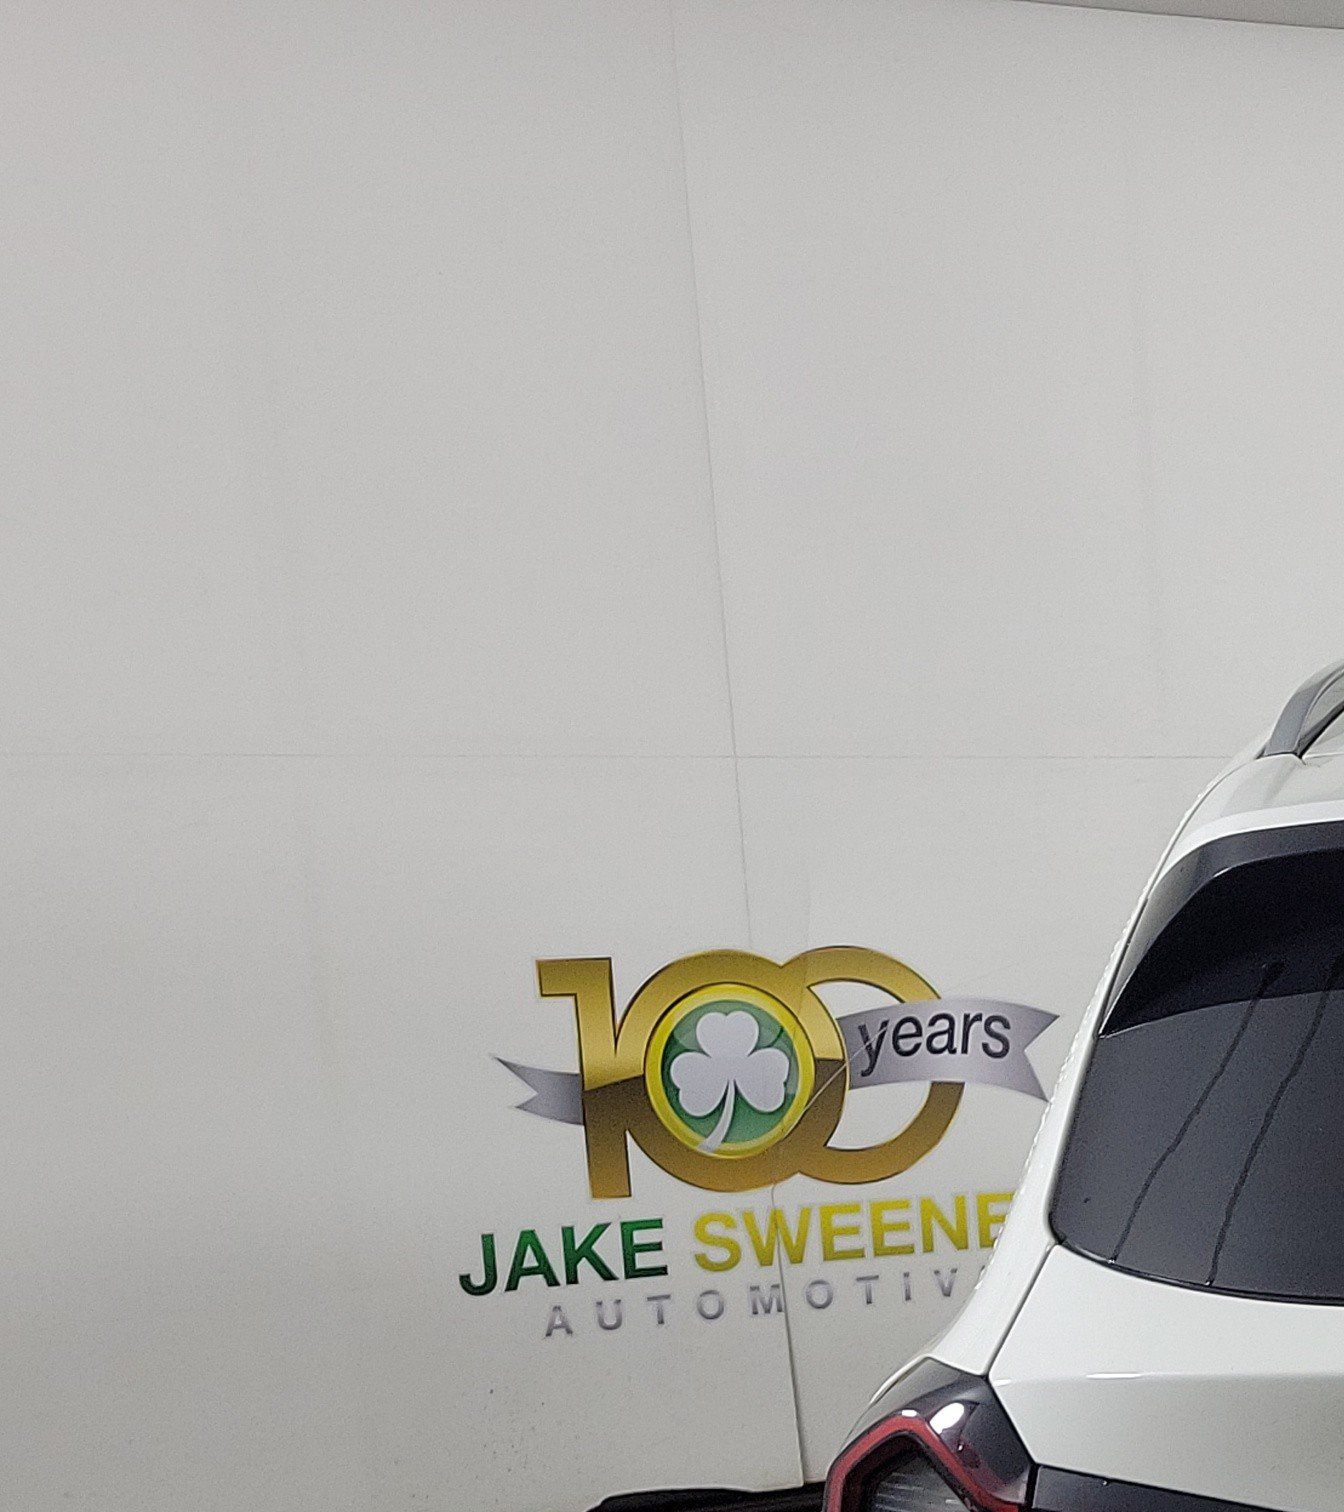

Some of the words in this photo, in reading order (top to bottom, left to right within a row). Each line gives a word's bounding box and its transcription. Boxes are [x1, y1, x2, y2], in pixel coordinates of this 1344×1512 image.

[536, 946, 964, 1199] 100
[859, 1011, 1011, 1076] years
[458, 1219, 668, 1296] JAKE
[693, 1191, 1015, 1272] SWEENE
[544, 1264, 985, 1337] AUTOMOTIV
